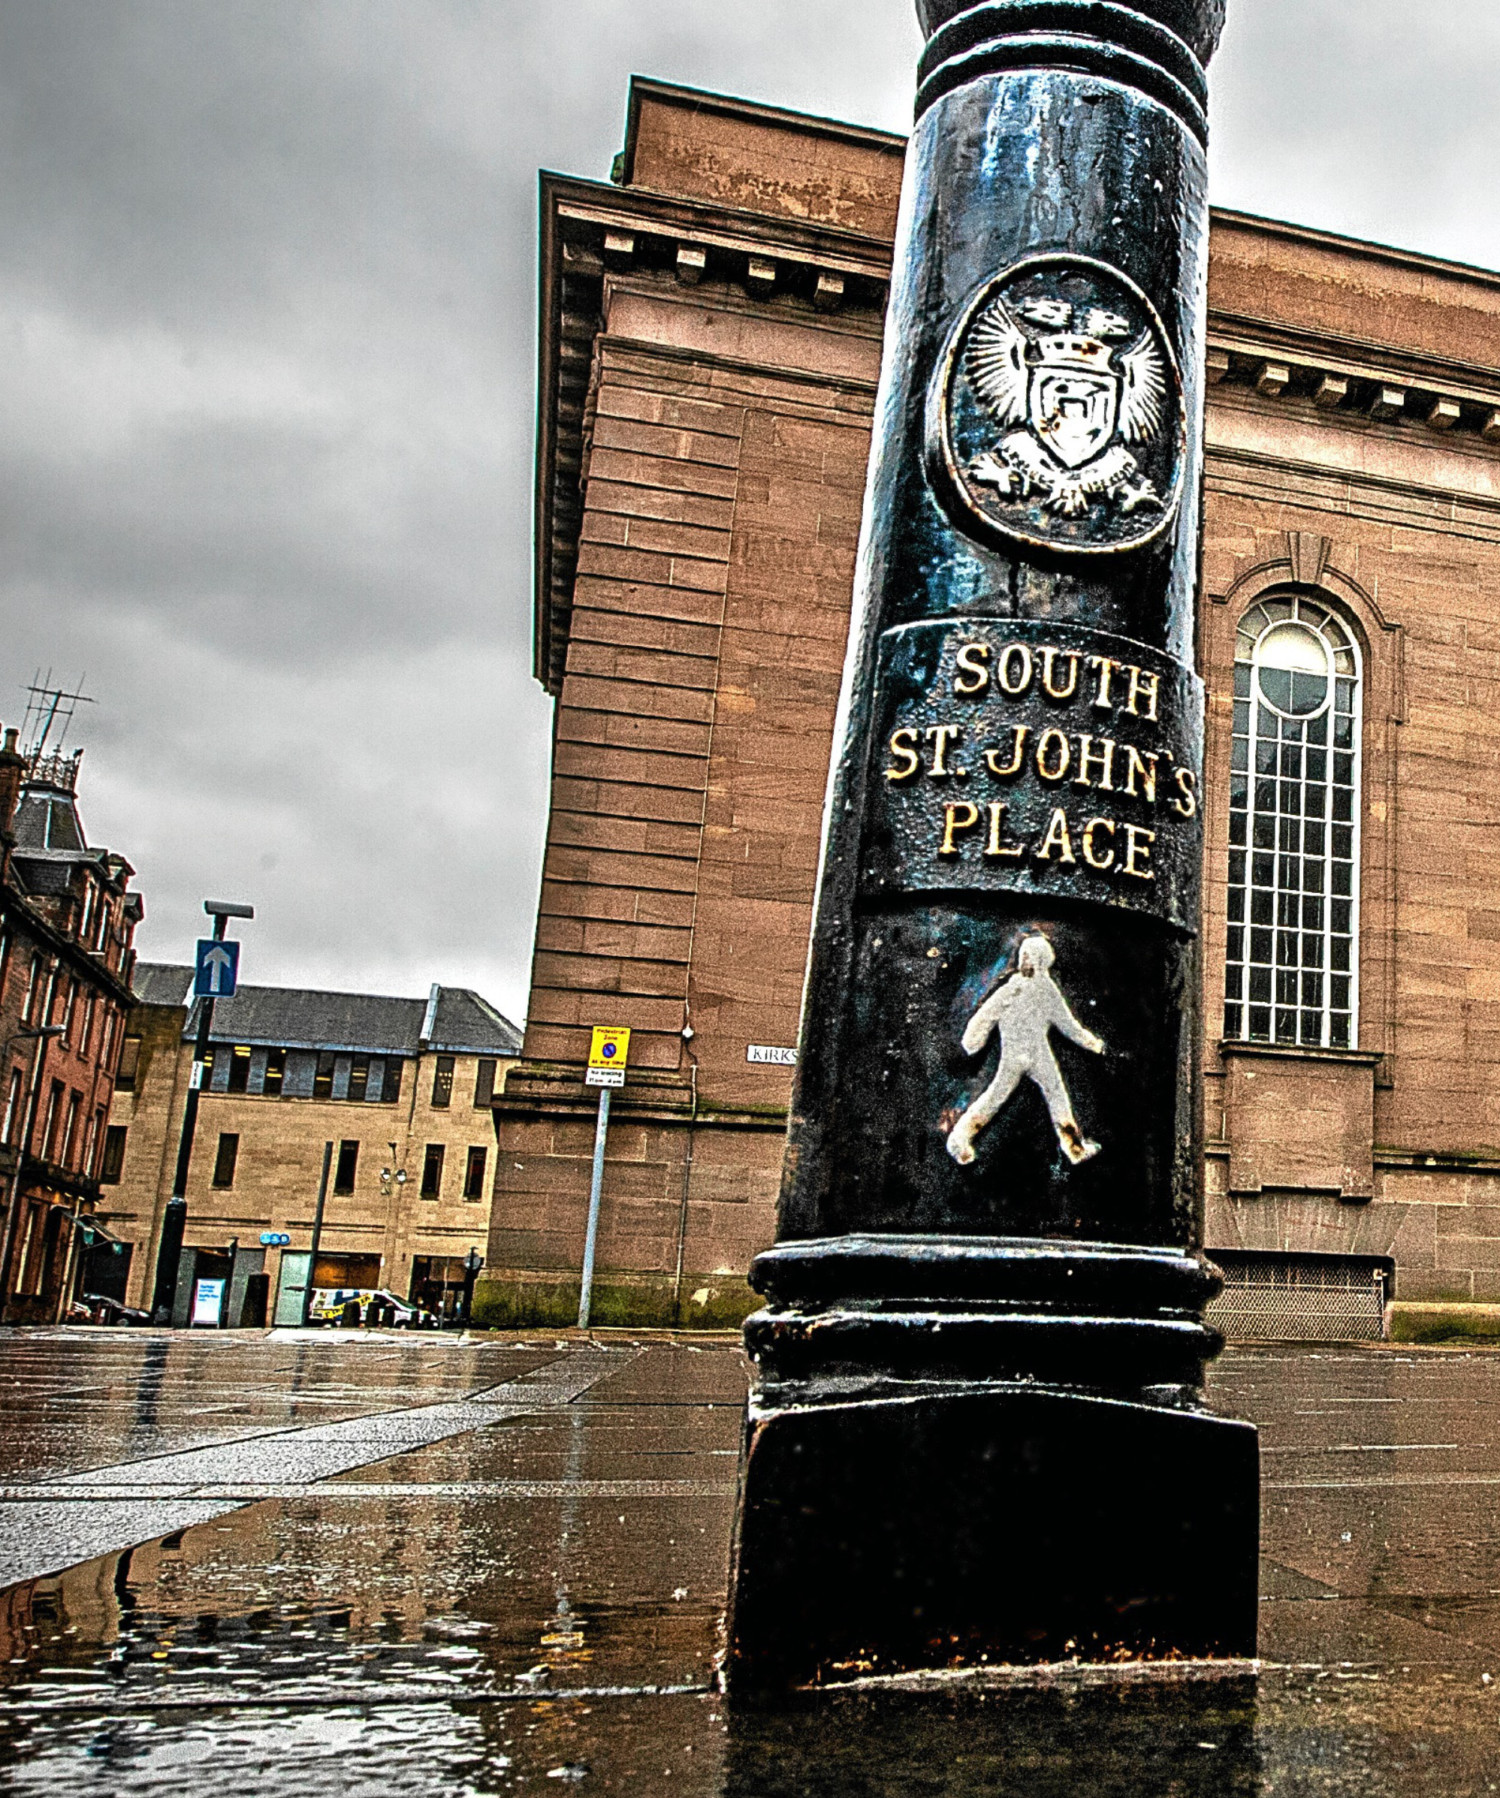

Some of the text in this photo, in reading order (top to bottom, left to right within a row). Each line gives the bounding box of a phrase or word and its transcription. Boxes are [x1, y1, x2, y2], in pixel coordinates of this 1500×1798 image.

[954, 643, 1161, 722] SOUTH
[886, 724, 1197, 818] ST. JOHN'S
[939, 802, 1156, 880] PLACE
